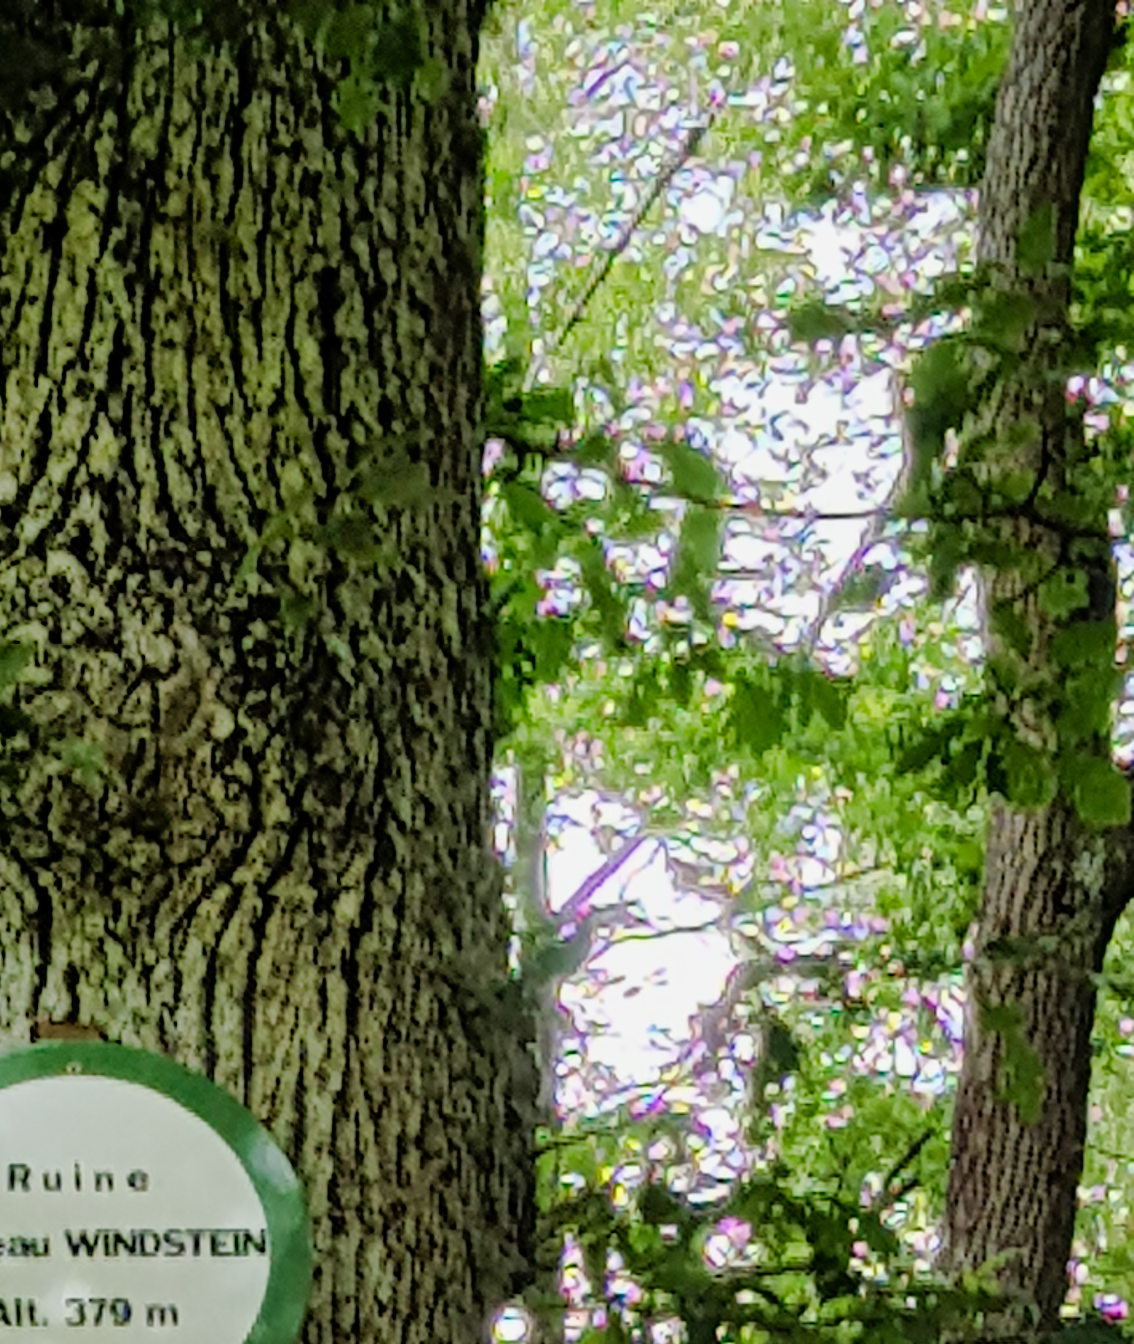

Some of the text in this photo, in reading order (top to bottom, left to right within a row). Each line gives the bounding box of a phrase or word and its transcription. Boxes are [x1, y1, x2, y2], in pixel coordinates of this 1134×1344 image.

[8, 1161, 149, 1192] Ruine
[65, 1228, 267, 1258] WINDSTEIN
[65, 1298, 132, 1328] 379
[147, 1303, 179, 1327] m
